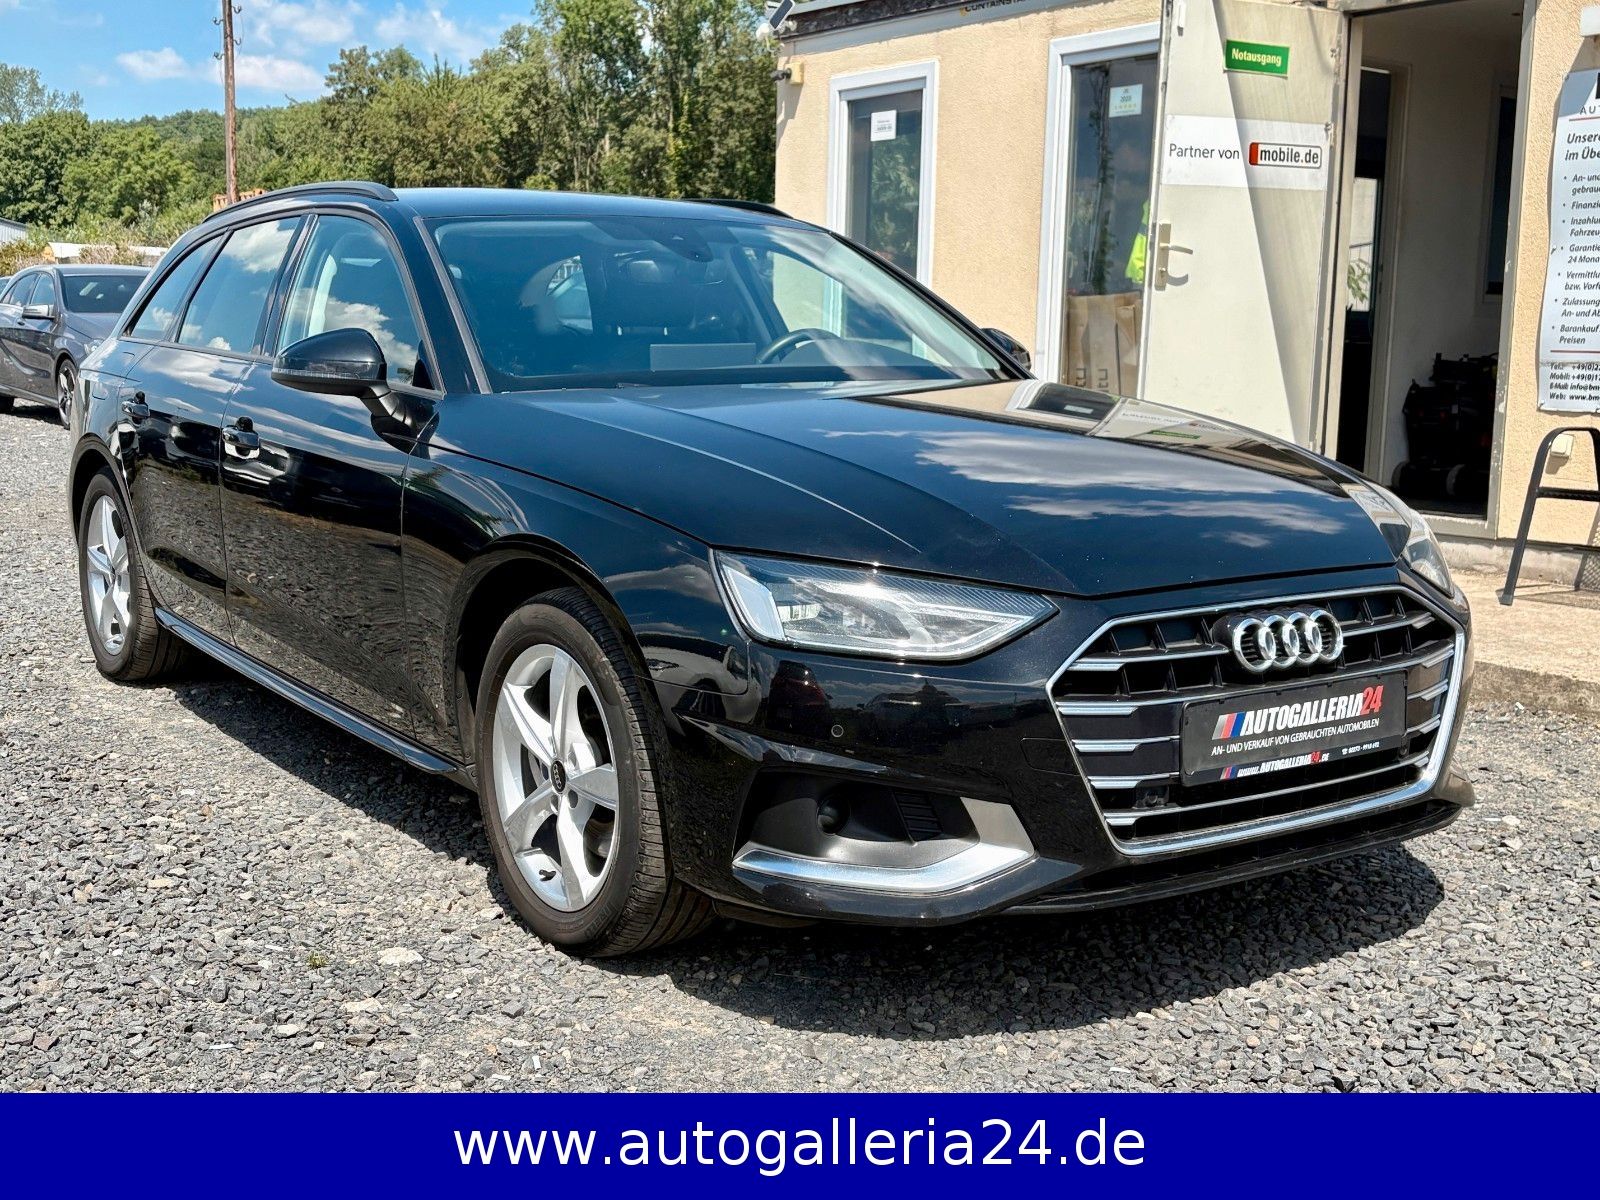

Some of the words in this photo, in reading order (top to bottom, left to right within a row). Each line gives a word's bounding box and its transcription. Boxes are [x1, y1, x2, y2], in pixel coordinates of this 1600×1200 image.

[1231, 48, 1282, 67] Notausgang
[1580, 105, 1600, 115] AU
[1169, 143, 1215, 159] Partner
[1219, 149, 1240, 160] von
[1259, 147, 1319, 164] mobile.de
[1565, 149, 1579, 160] im
[1572, 174, 1585, 182] An-
[1571, 184, 1600, 196] gebrau
[1569, 228, 1600, 238] Fahrzeu
[1564, 282, 1581, 290] bzw.
[1583, 281, 1600, 290] Vorf
[1561, 309, 1574, 317] An-
[1575, 309, 1591, 317] und
[1560, 324, 1599, 333] Barankauf
[1559, 335, 1586, 344] Preisen
[1549, 392, 1566, 400] Web:
[1239, 685, 1384, 737] AUTOGALLERIA24
[1211, 745, 1226, 756] AN-
[1226, 742, 1243, 753] UND
[1243, 736, 1275, 750] VERKAUF
[1274, 732, 1290, 745] VON
[1290, 726, 1337, 742] GEBRAUCHTEN
[1336, 718, 1380, 734] AUTOMOBILEN
